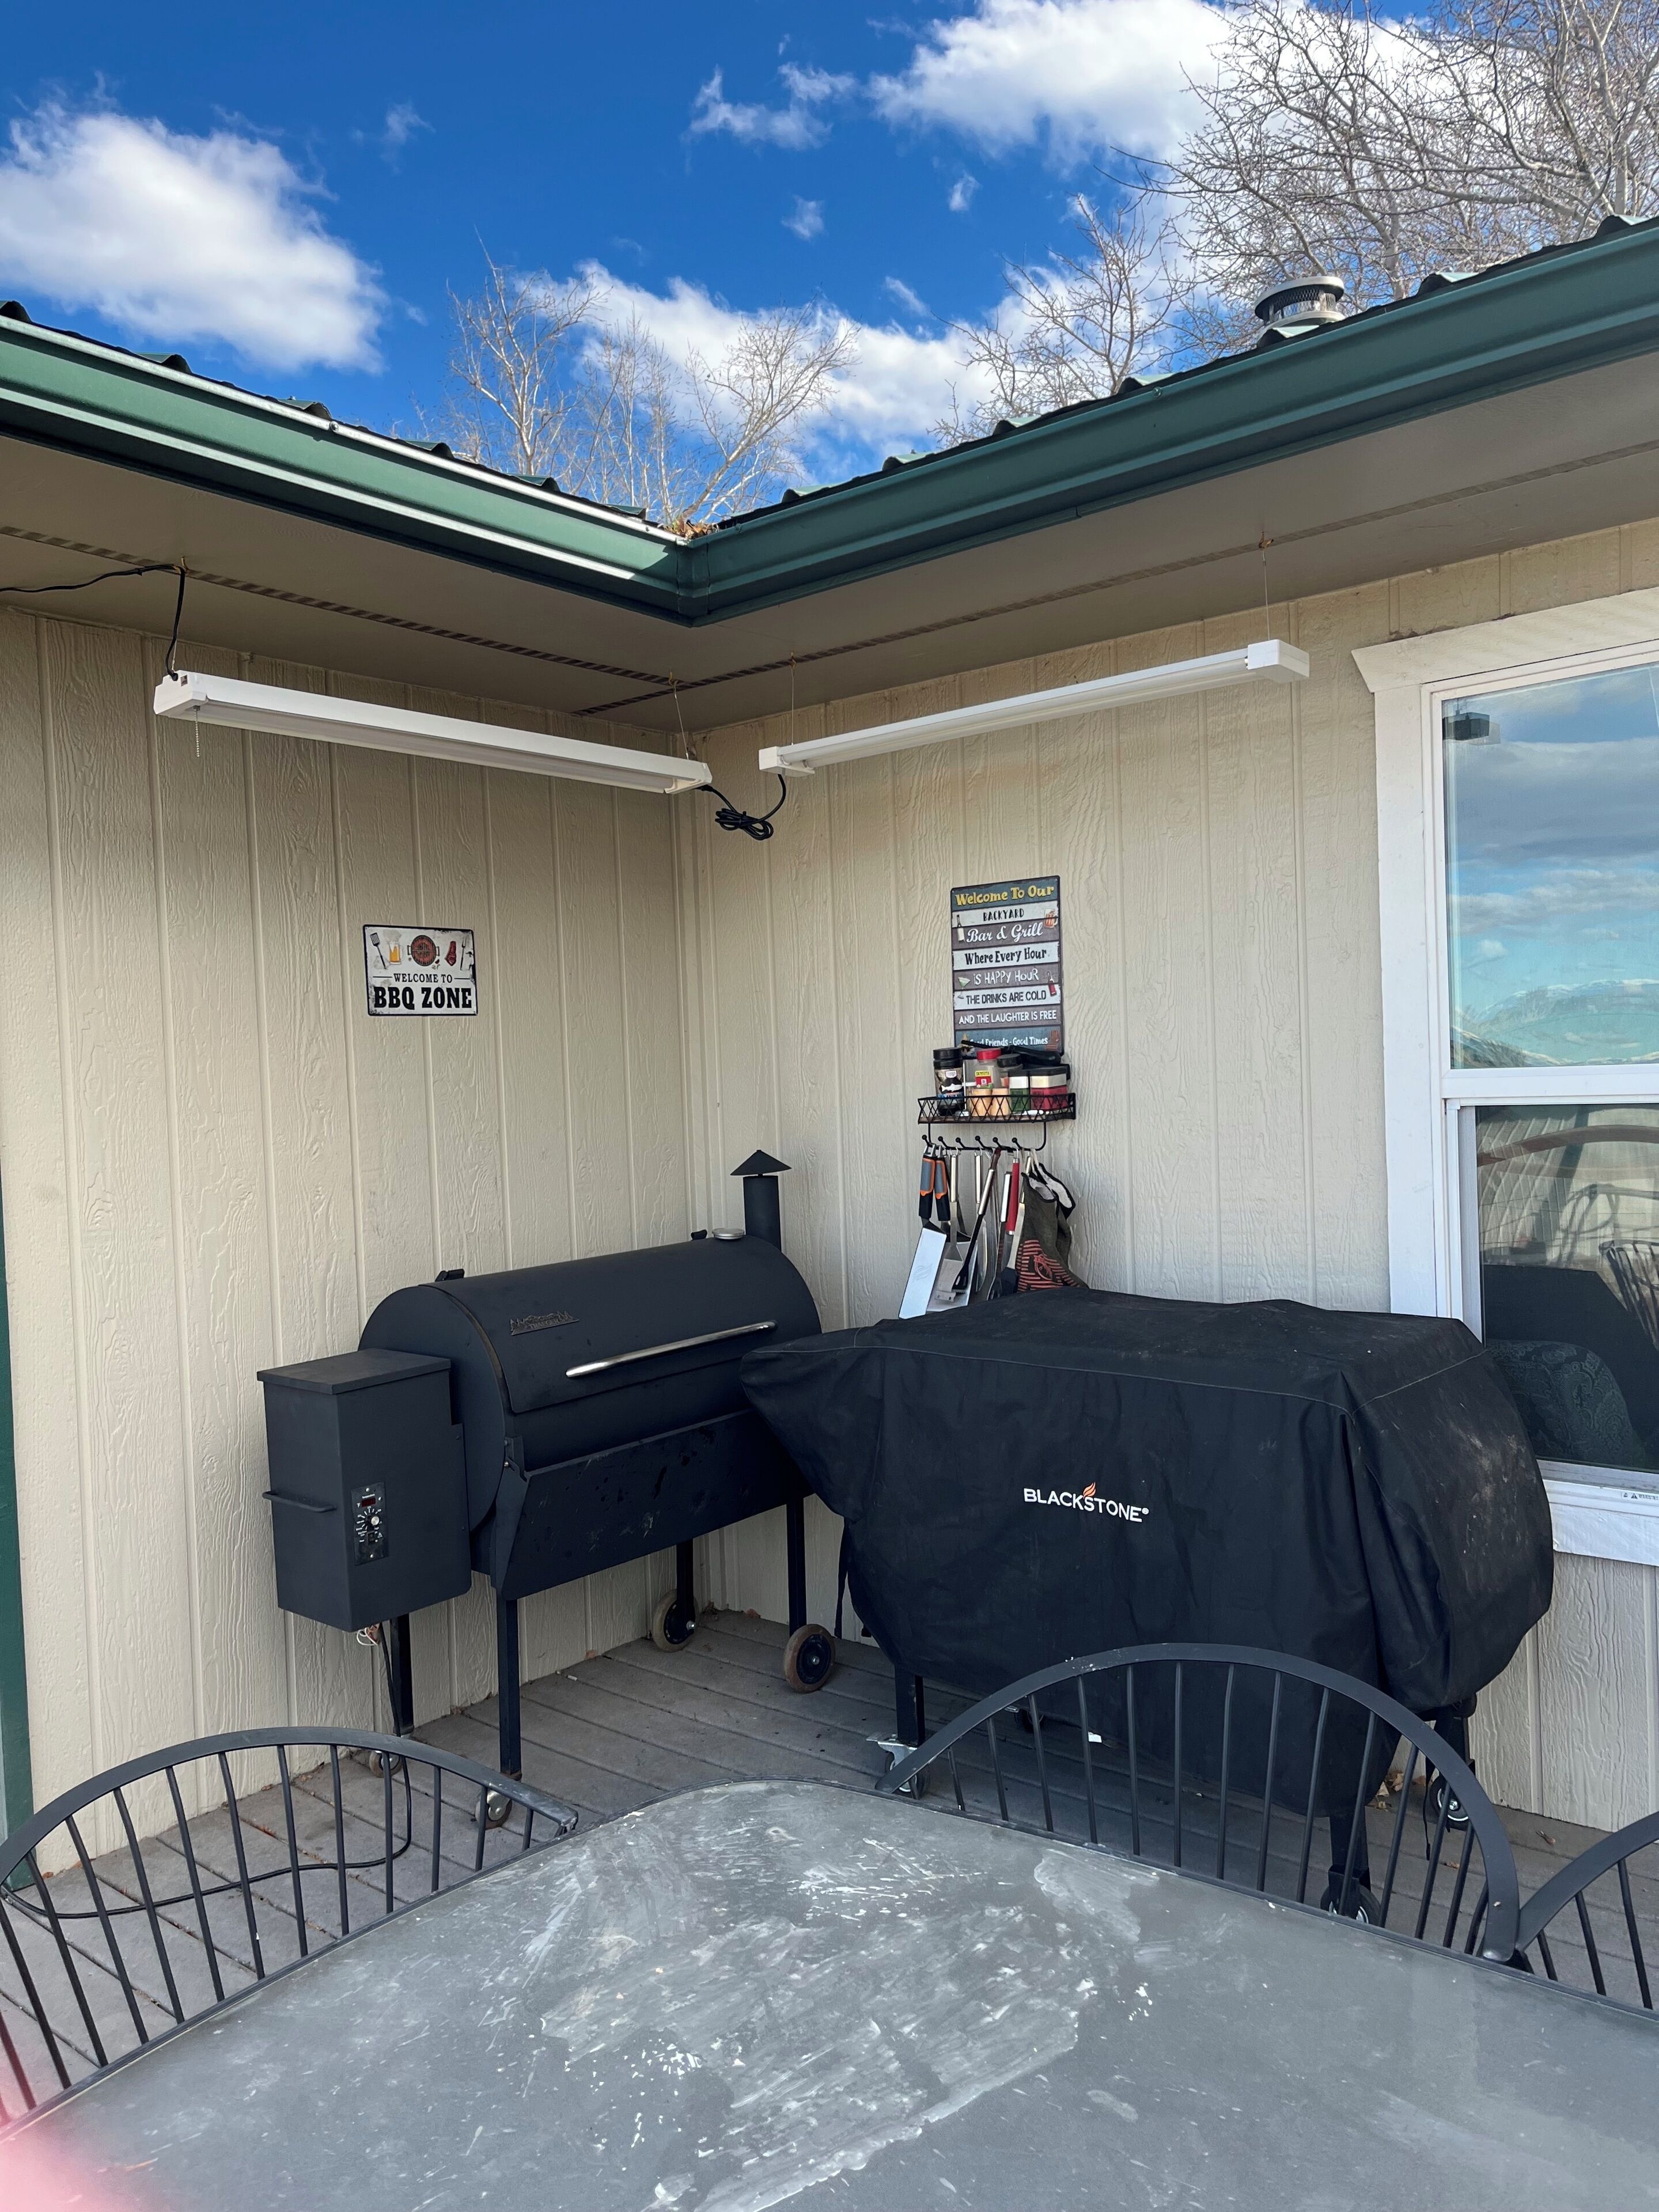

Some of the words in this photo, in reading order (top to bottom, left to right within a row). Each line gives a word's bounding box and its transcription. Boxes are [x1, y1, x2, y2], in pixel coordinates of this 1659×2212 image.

[955, 891, 1008, 906] Welcome
[1010, 887, 1025, 900] To
[1027, 885, 1055, 897] Our
[983, 908, 1025, 922] BACKYARD
[966, 929, 993, 943] Bar
[996, 925, 1007, 940] &
[1011, 922, 1044, 943] Grill
[964, 952, 993, 965] Where
[995, 949, 1022, 963] Every
[1024, 947, 1047, 960] Hour
[393, 973, 438, 983] WELCOME
[441, 974, 453, 983] TO
[984, 970, 1011, 985] HAPPY
[373, 986, 415, 1010] BBQ
[421, 986, 472, 1009] ZONE
[966, 995, 980, 1005] THE
[982, 993, 1007, 1004] DRINKS
[1009, 991, 1024, 1002] ARE
[1025, 990, 1047, 1001] COLD
[959, 1014, 975, 1025] AND
[976, 1014, 990, 1024] THE
[991, 1012, 1029, 1023] LAUGHTER
[1031, 1010, 1038, 1020] IS
[1040, 1010, 1057, 1020] FREE
[985, 1037, 1009, 1047] Friends
[1013, 1036, 1028, 1046] Good
[1029, 1036, 1048, 1046] Times
